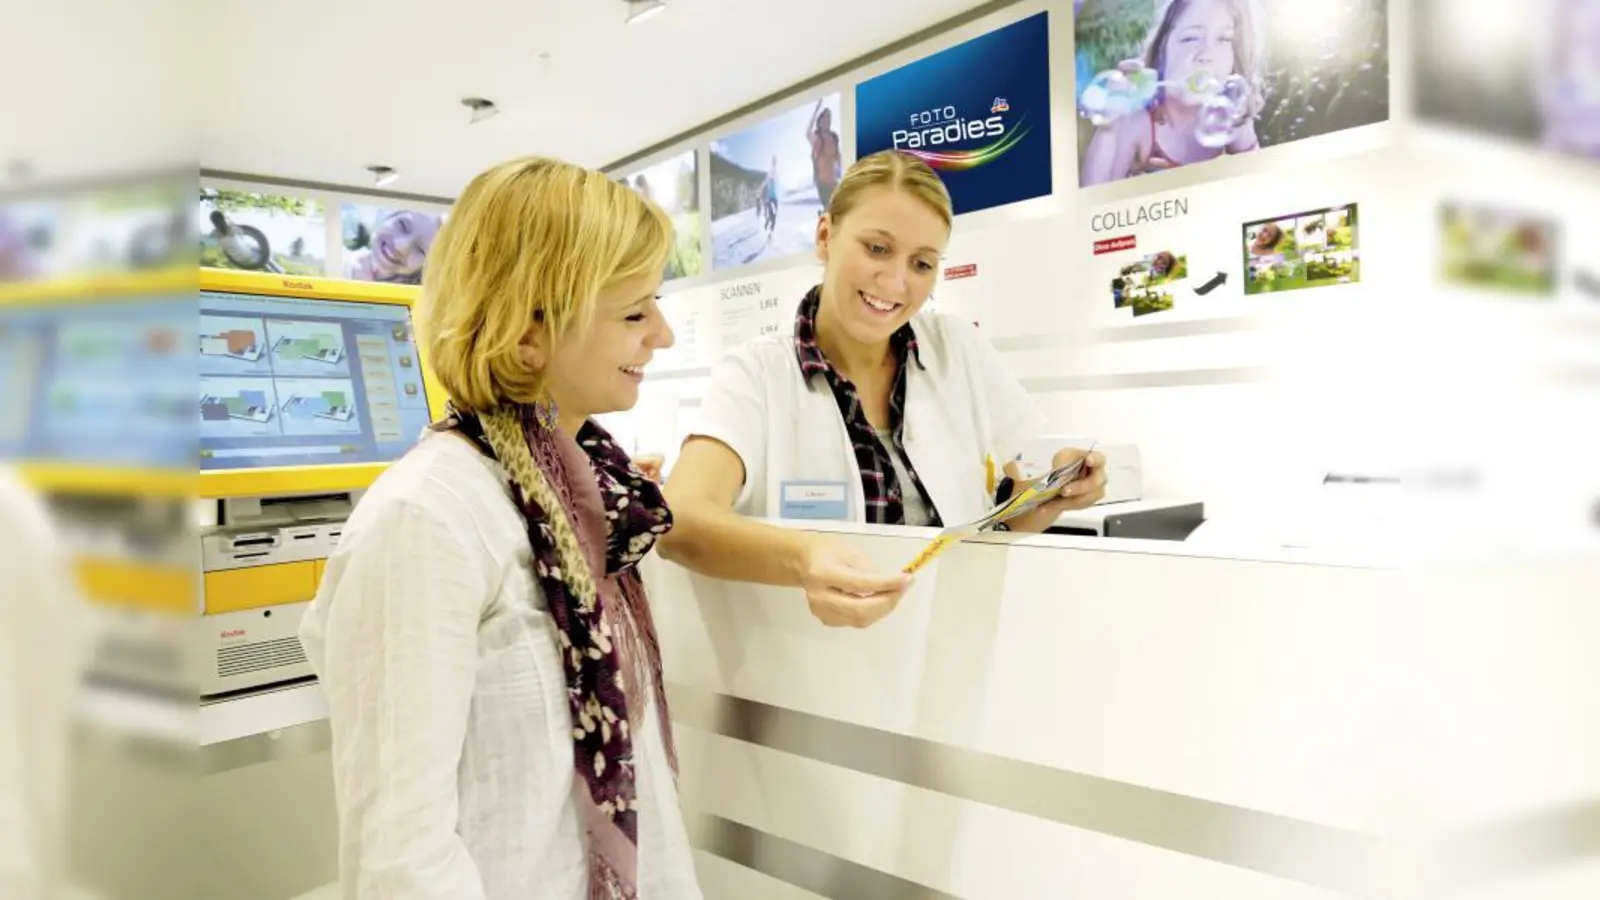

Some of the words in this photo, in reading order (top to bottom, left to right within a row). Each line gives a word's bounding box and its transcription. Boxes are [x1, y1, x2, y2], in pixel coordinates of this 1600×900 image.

[910, 106, 956, 126] FOTO
[892, 116, 1004, 149] Paradies
[1091, 197, 1188, 232] COLLAGEN
[283, 279, 314, 290] Kodak
[720, 281, 761, 301] SCANNEN
[220, 629, 246, 639] Kodak
